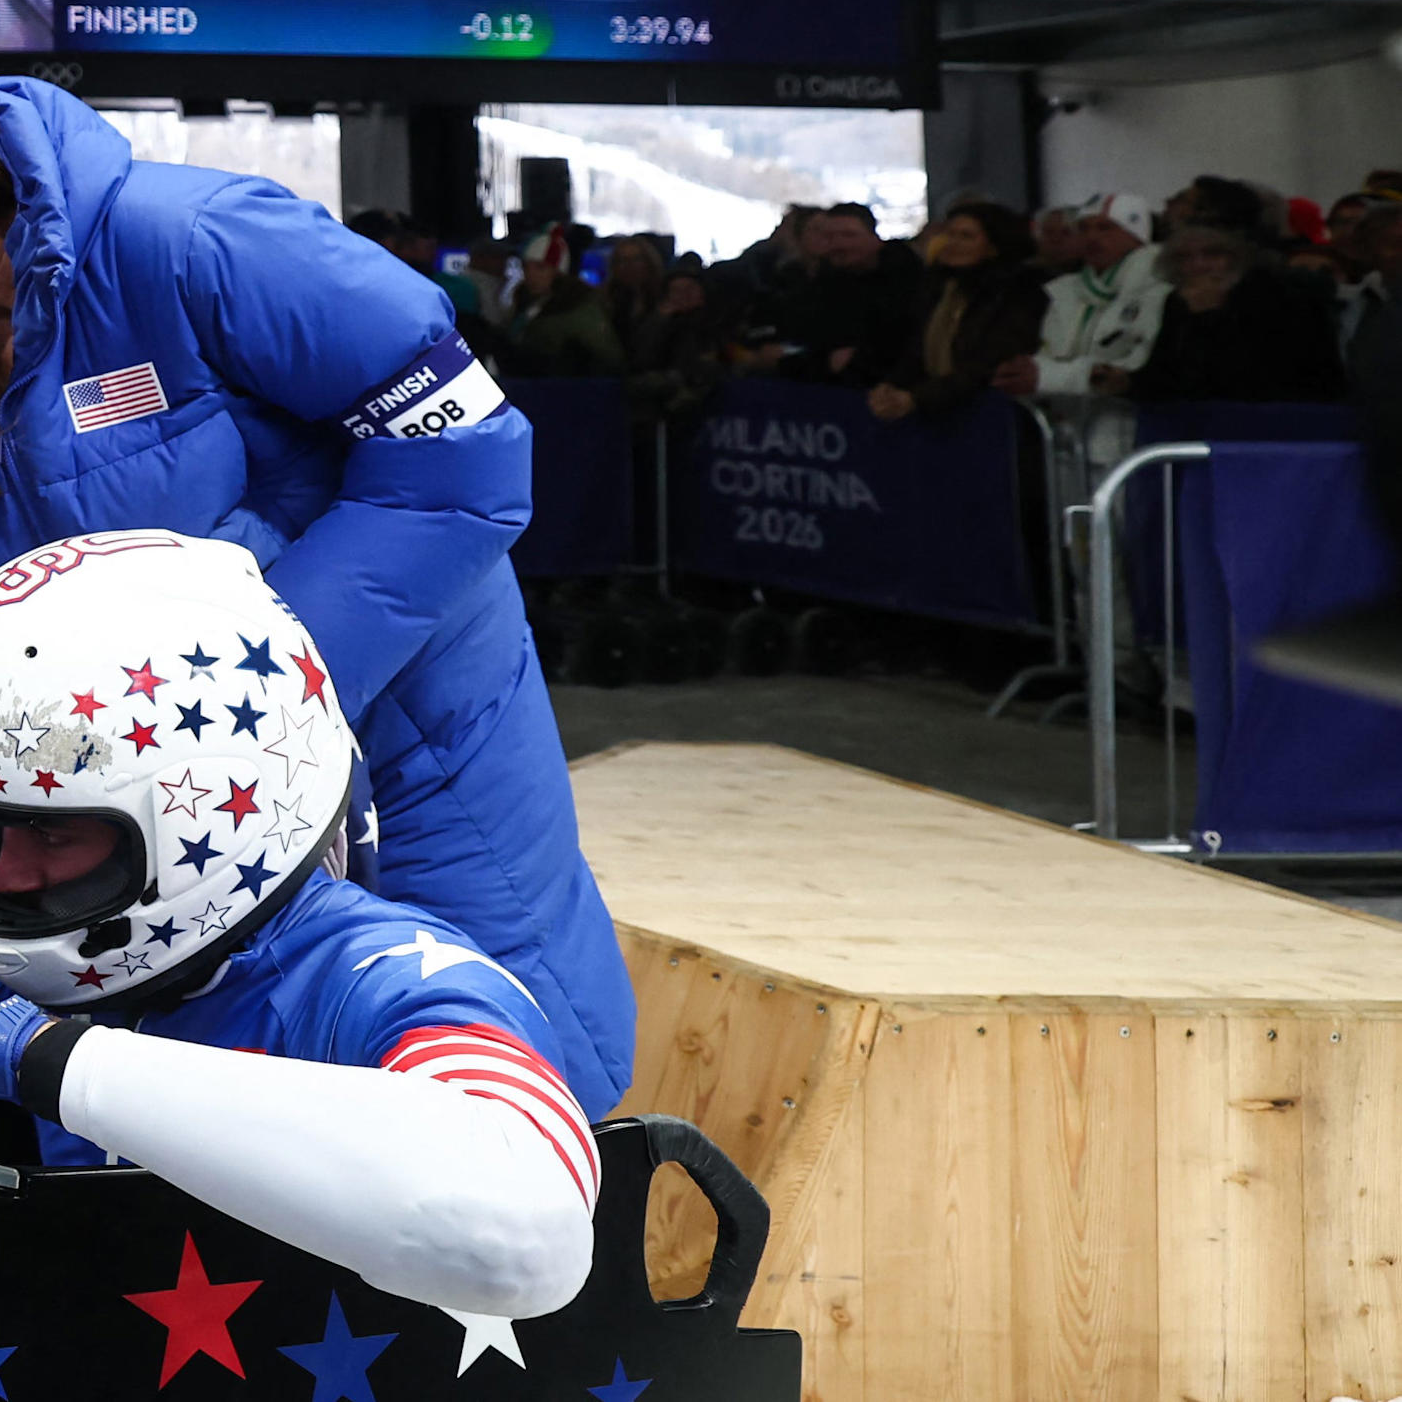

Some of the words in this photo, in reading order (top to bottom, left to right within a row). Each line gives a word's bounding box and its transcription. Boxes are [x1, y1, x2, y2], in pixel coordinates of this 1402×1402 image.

[67, 5, 197, 35] FINISHED
[460, 13, 534, 42] -0.12
[609, 15, 714, 45] 3:39.94
[364, 365, 438, 418] FINISH
[708, 418, 847, 461] MILANO
[710, 460, 882, 513] CORTINA
[734, 505, 825, 550] 2026
